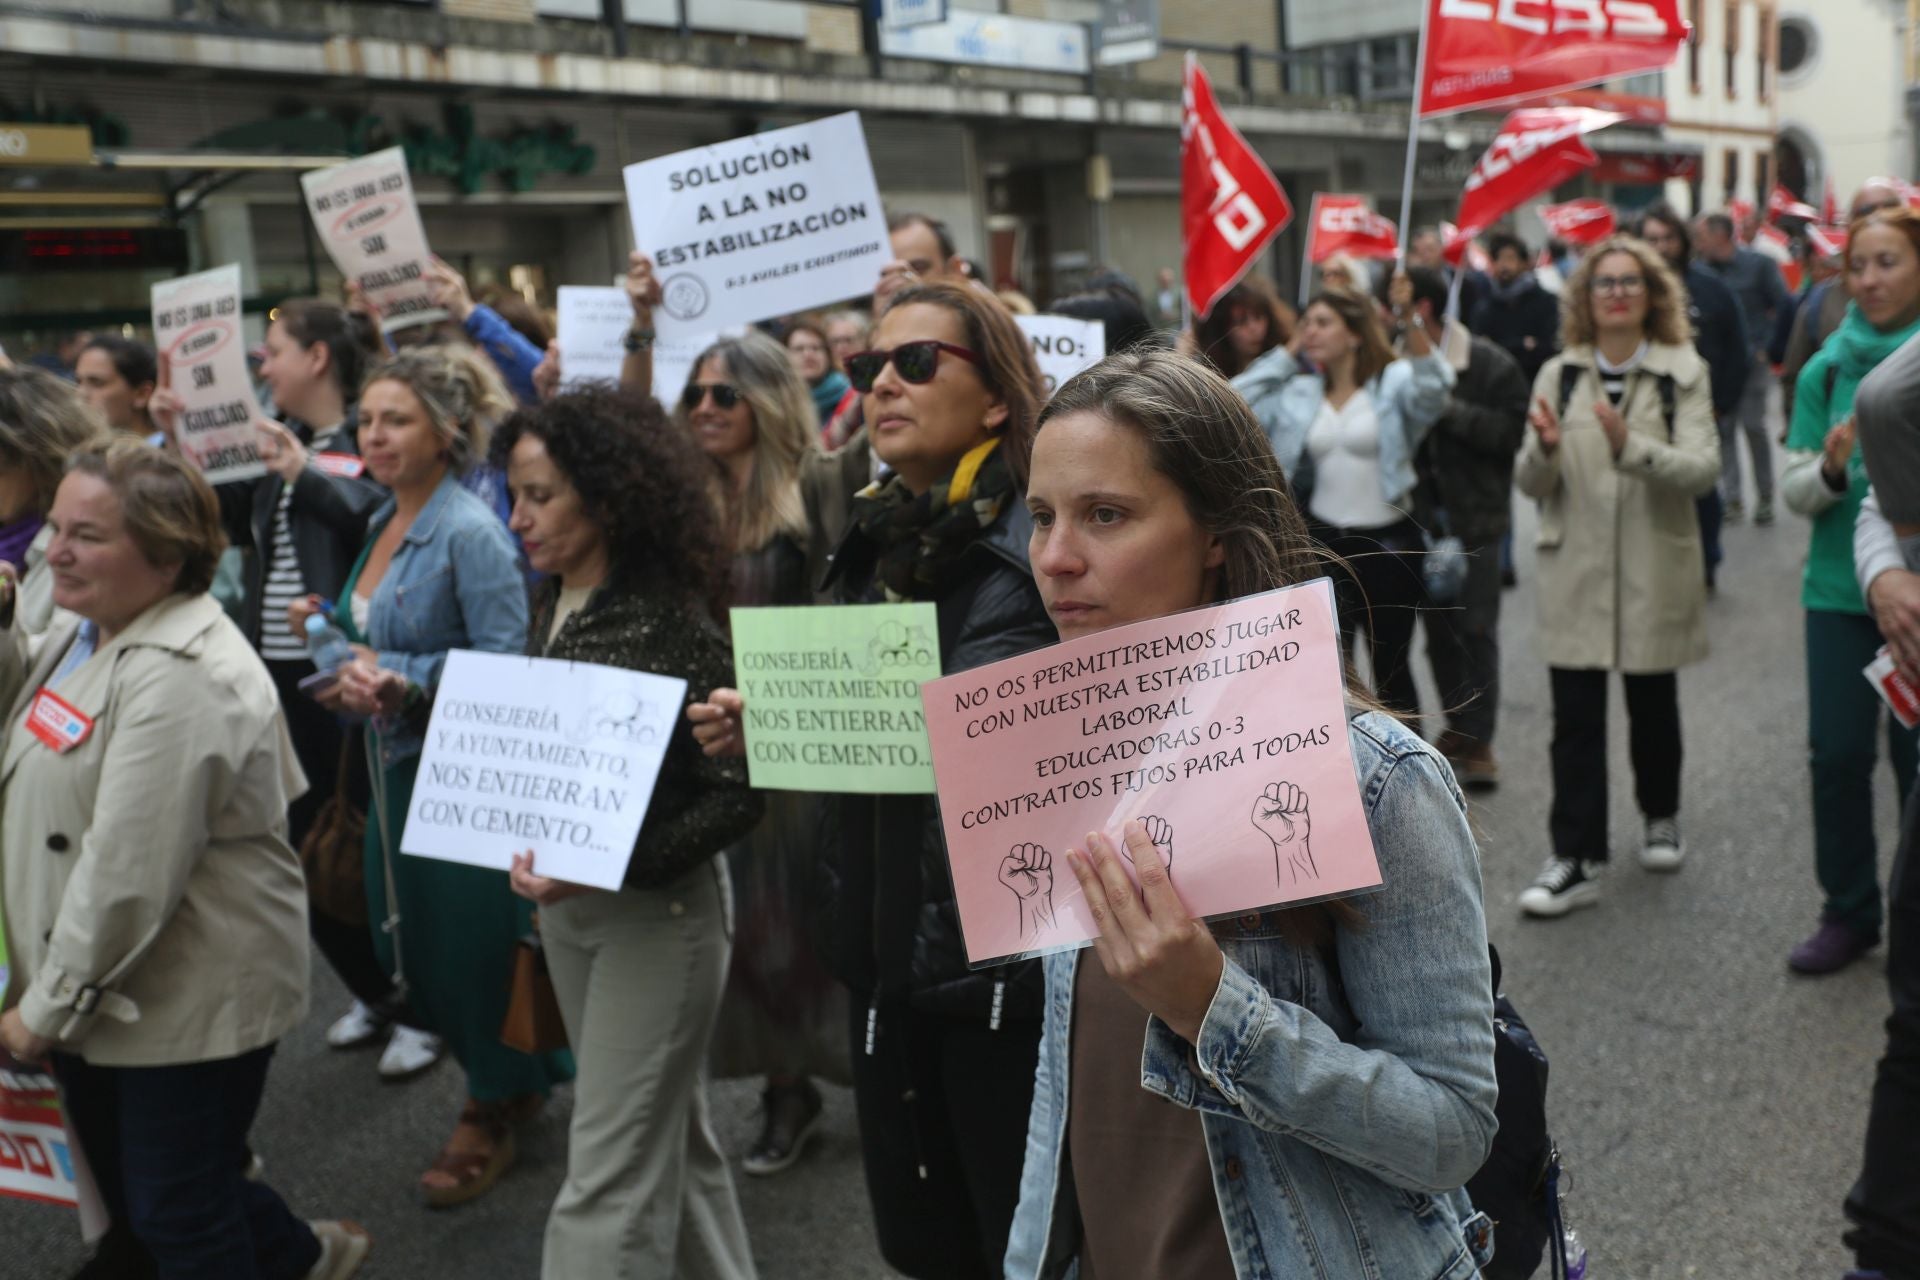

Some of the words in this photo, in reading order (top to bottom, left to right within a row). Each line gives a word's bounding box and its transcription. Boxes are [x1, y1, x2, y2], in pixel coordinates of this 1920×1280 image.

[669, 143, 812, 192] SOLUCIÓN
[696, 204, 716, 225] A
[722, 194, 759, 219] LA
[766, 182, 808, 208] NO
[655, 201, 868, 268] ESTABILIZACIÓN
[803, 240, 881, 272] EXISTIMOS
[1031, 335, 1085, 357] NO:
[742, 647, 853, 671] CONSEJERÍA
[954, 686, 989, 713] NO
[996, 674, 1026, 699] OS
[1032, 627, 1217, 691] PERMITIREMOS
[1223, 608, 1303, 648] JUGAR
[745, 679, 757, 698] Y
[966, 714, 1015, 739] CON
[1022, 682, 1129, 721] NUESTRA
[1136, 641, 1301, 694] ESTABILIDAD
[442, 698, 561, 732] CONSEJERÍA
[749, 708, 790, 730] NOS
[796, 710, 928, 732] ENTIERRAN
[1081, 696, 1194, 736] LABORAL
[437, 729, 451, 749] Y
[454, 730, 631, 779] AYUNTAMIENTO,
[753, 740, 796, 763] CON
[1035, 724, 1201, 778] EDUCADORAS
[1207, 715, 1246, 740] 0-3
[427, 762, 472, 791] NOS
[476, 768, 628, 814] ENTIERRAN
[960, 776, 1104, 830] CONTRATOS
[1111, 765, 1177, 796] FIJOS
[1183, 746, 1245, 779] PARA
[1252, 724, 1331, 762] TODAS
[418, 798, 466, 827] CON
[470, 803, 611, 852] CEMENTO...
